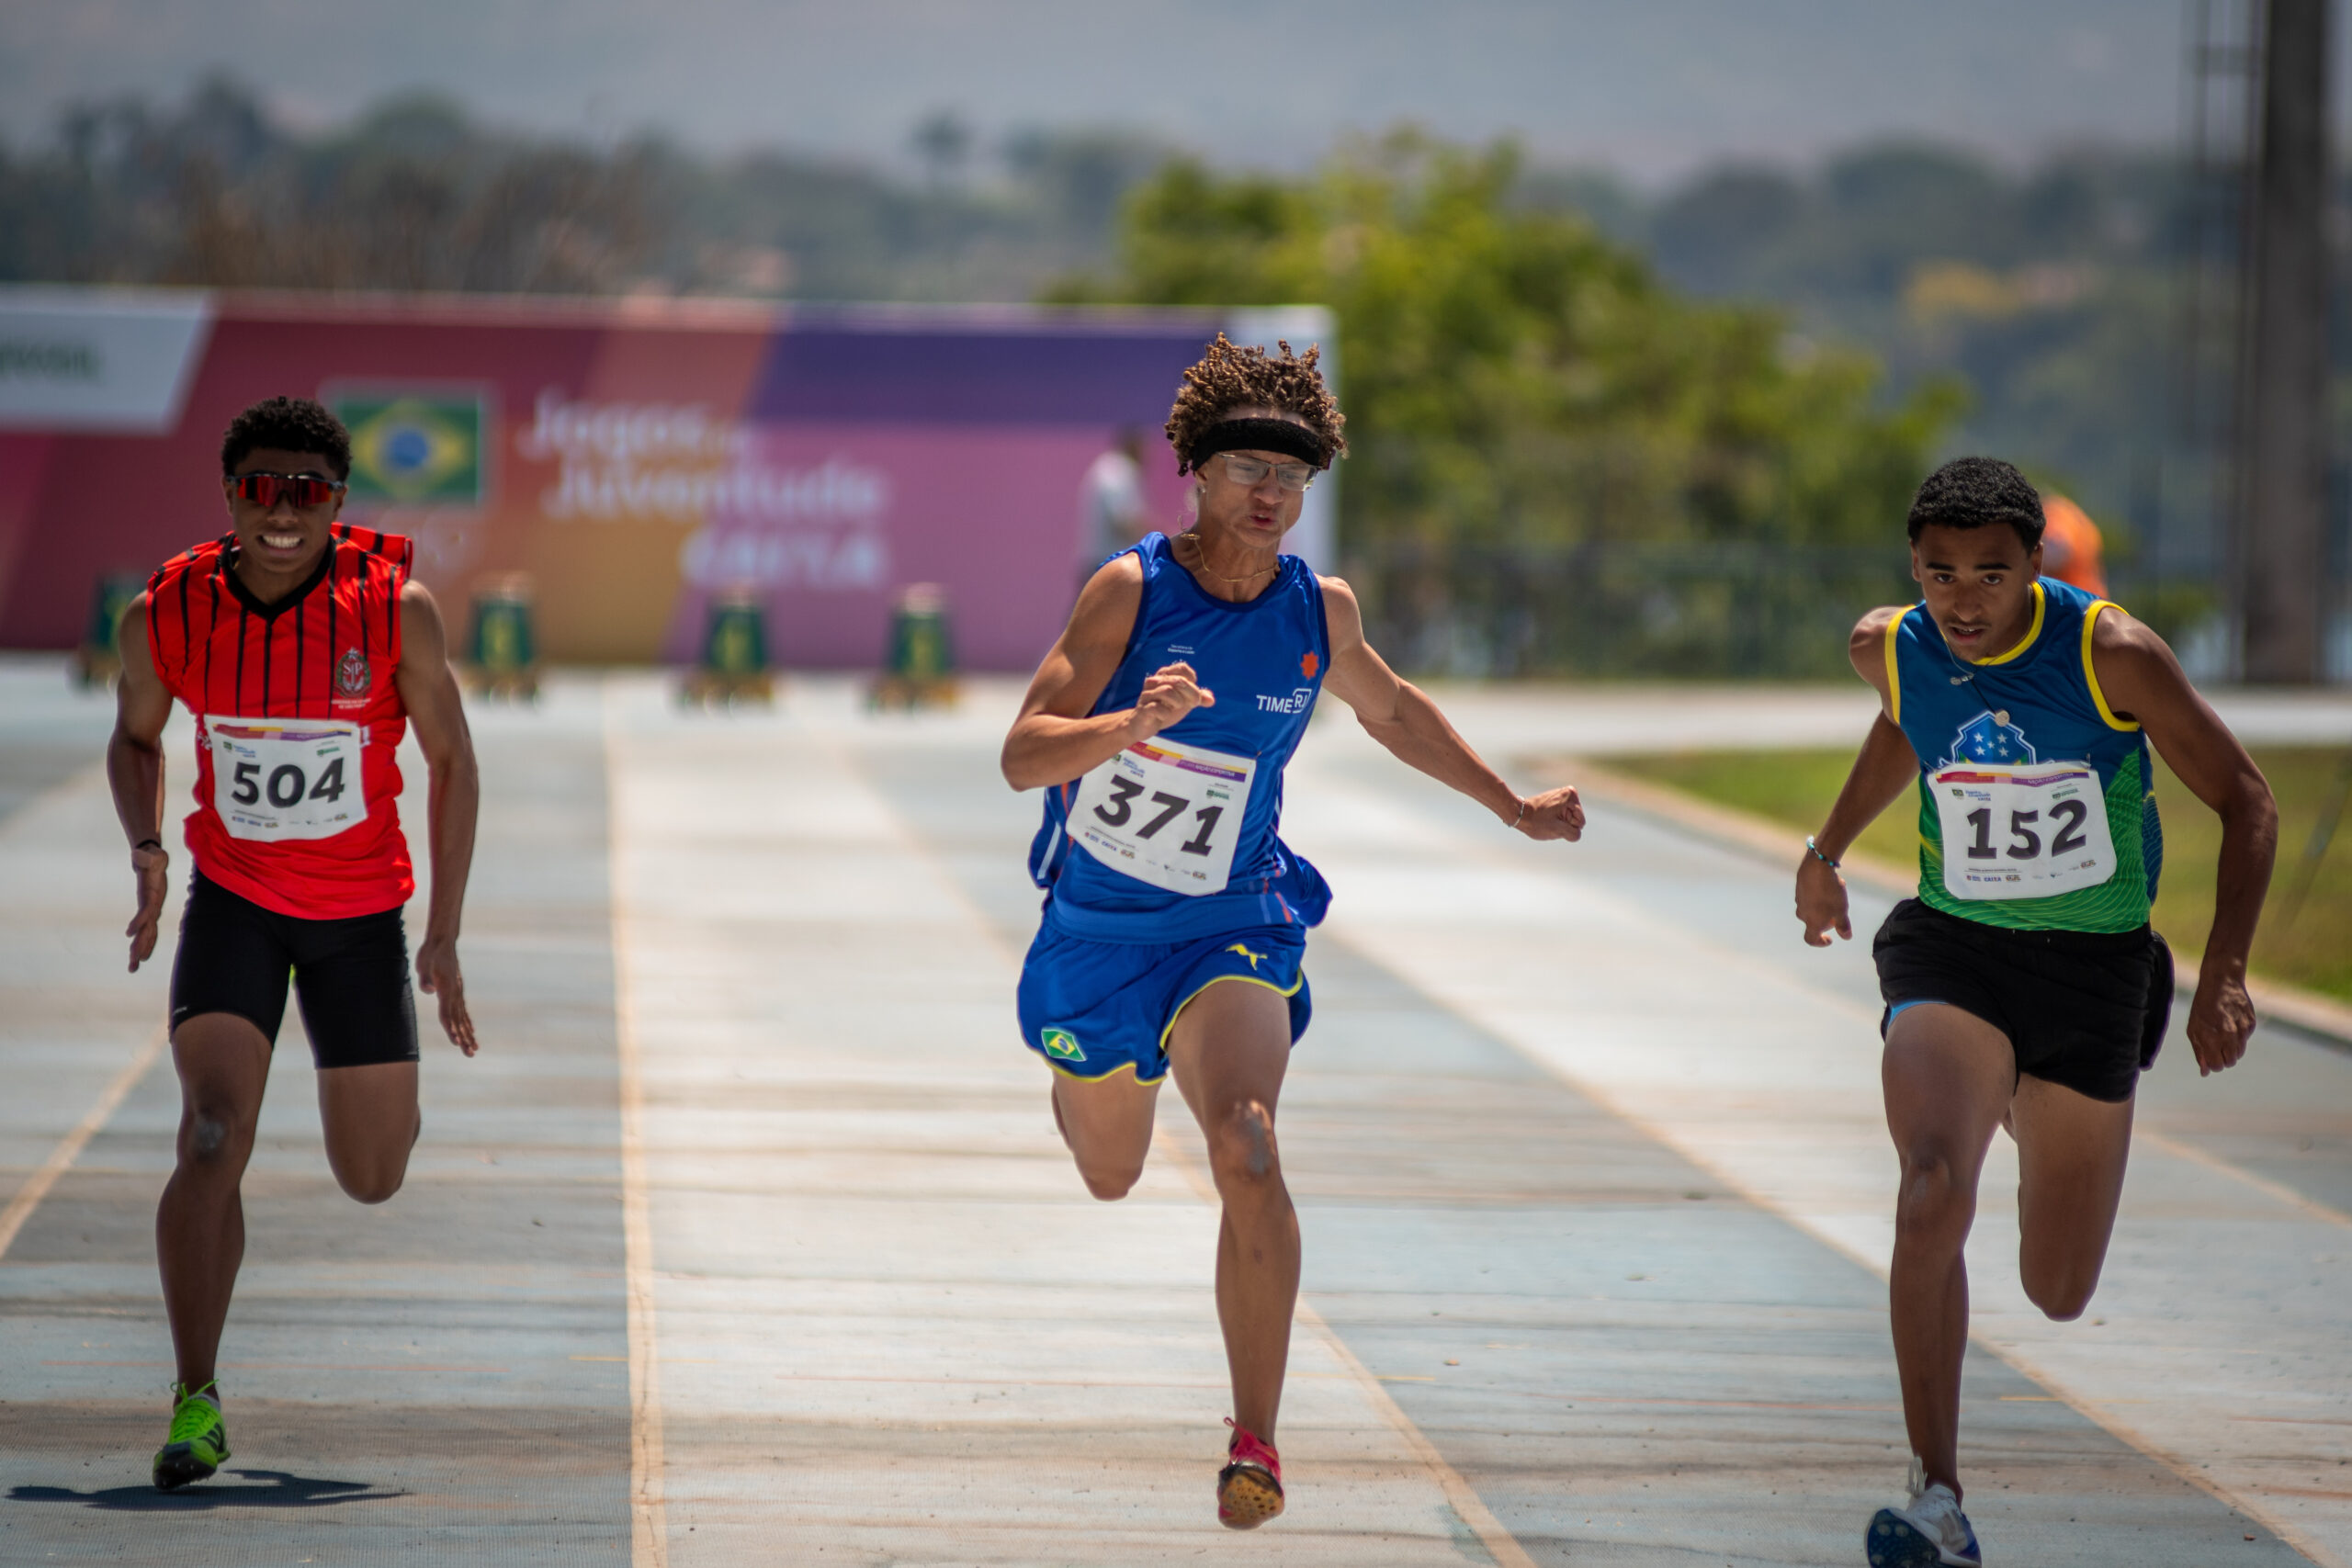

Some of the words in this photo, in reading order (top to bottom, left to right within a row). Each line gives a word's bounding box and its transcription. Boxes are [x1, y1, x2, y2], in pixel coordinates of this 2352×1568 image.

[1256, 694, 1293, 714] TIME
[231, 757, 345, 808] 504
[1093, 774, 1224, 857] 371
[1966, 799, 2087, 861] 152
